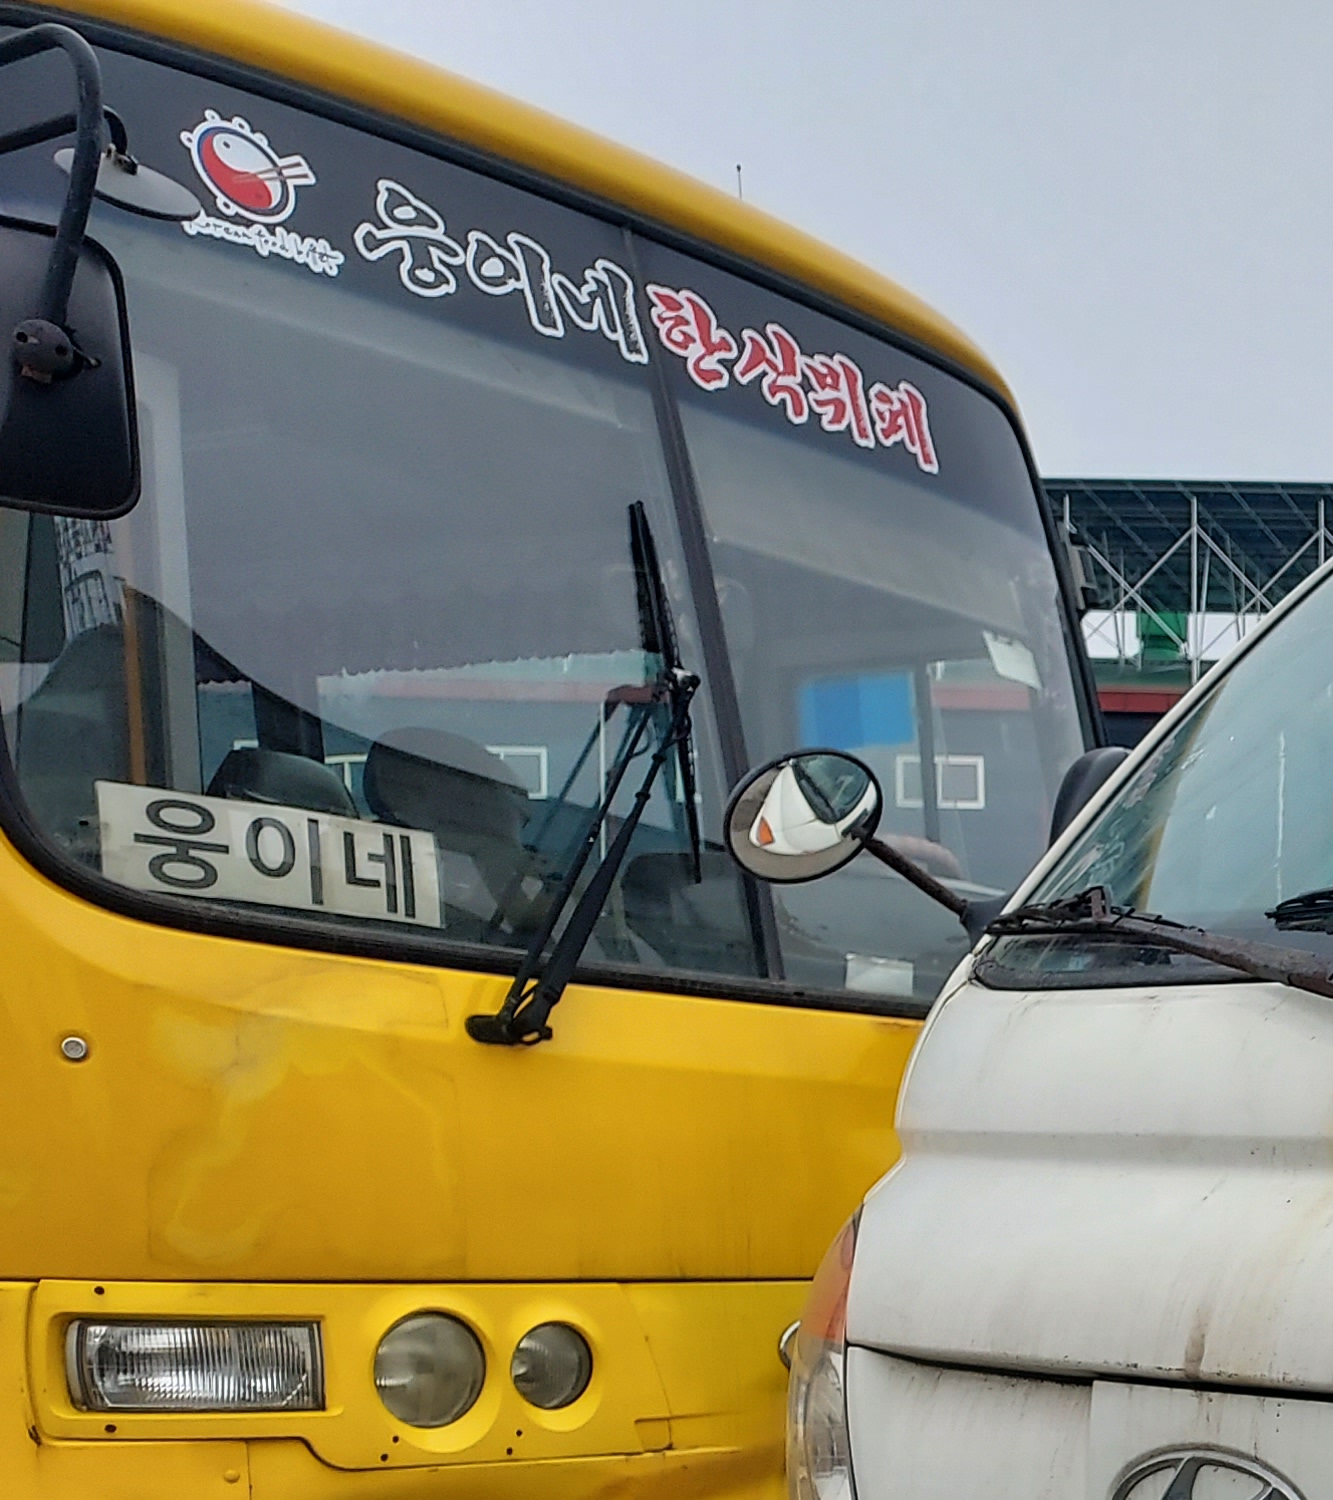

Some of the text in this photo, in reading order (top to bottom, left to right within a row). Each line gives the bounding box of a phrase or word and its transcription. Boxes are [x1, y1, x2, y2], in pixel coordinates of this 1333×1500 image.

[354, 179, 939, 474] 웅이네 한식뷔페
[134, 799, 416, 918] 웅이네
